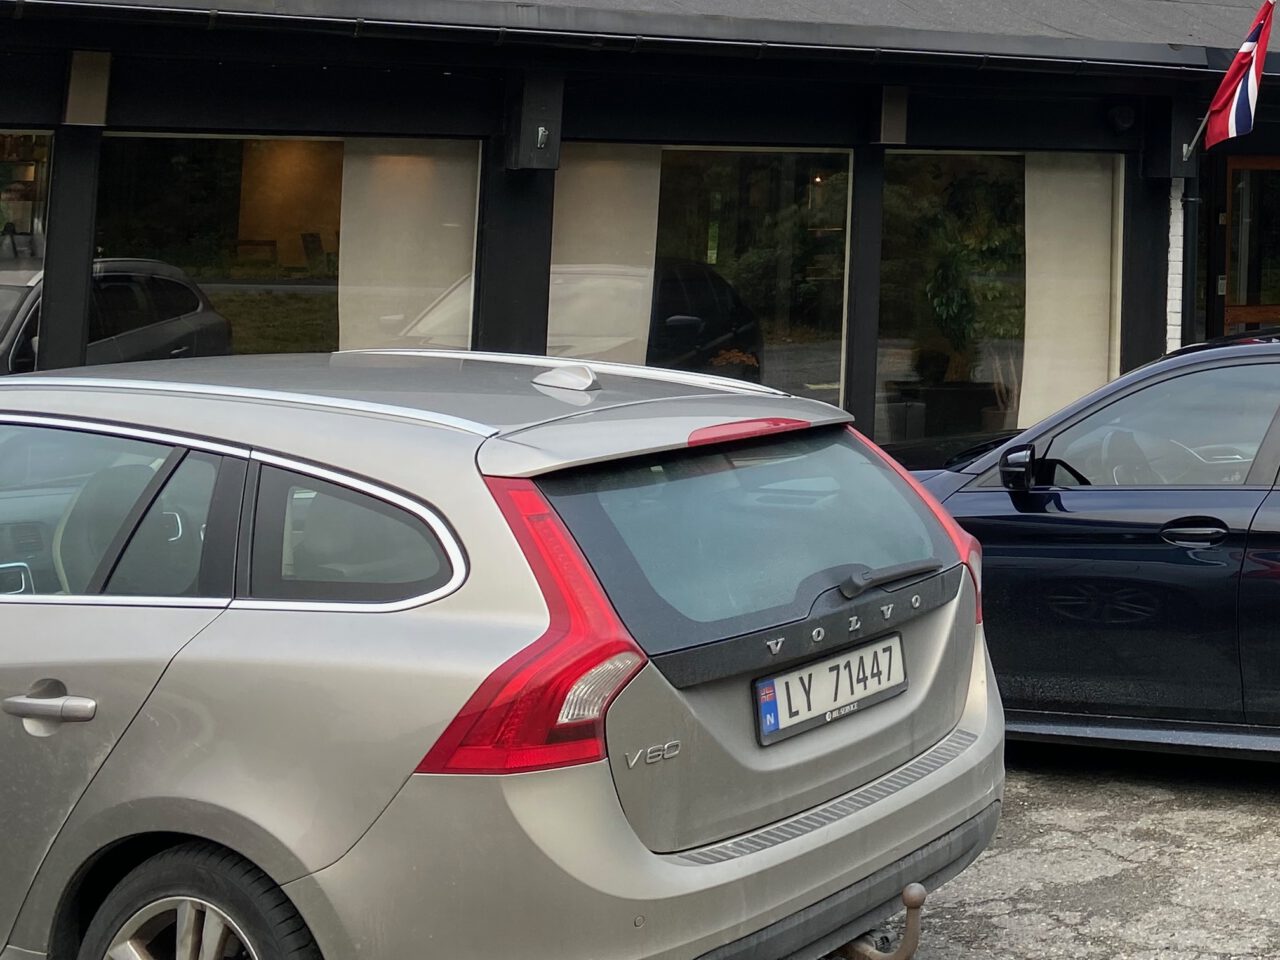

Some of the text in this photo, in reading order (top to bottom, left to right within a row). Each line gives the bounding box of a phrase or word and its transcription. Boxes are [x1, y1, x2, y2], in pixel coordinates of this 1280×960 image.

[766, 594, 921, 655] VOLVO
[785, 645, 893, 719] LY 71447
[765, 713, 775, 726] N
[625, 740, 680, 769] V60
